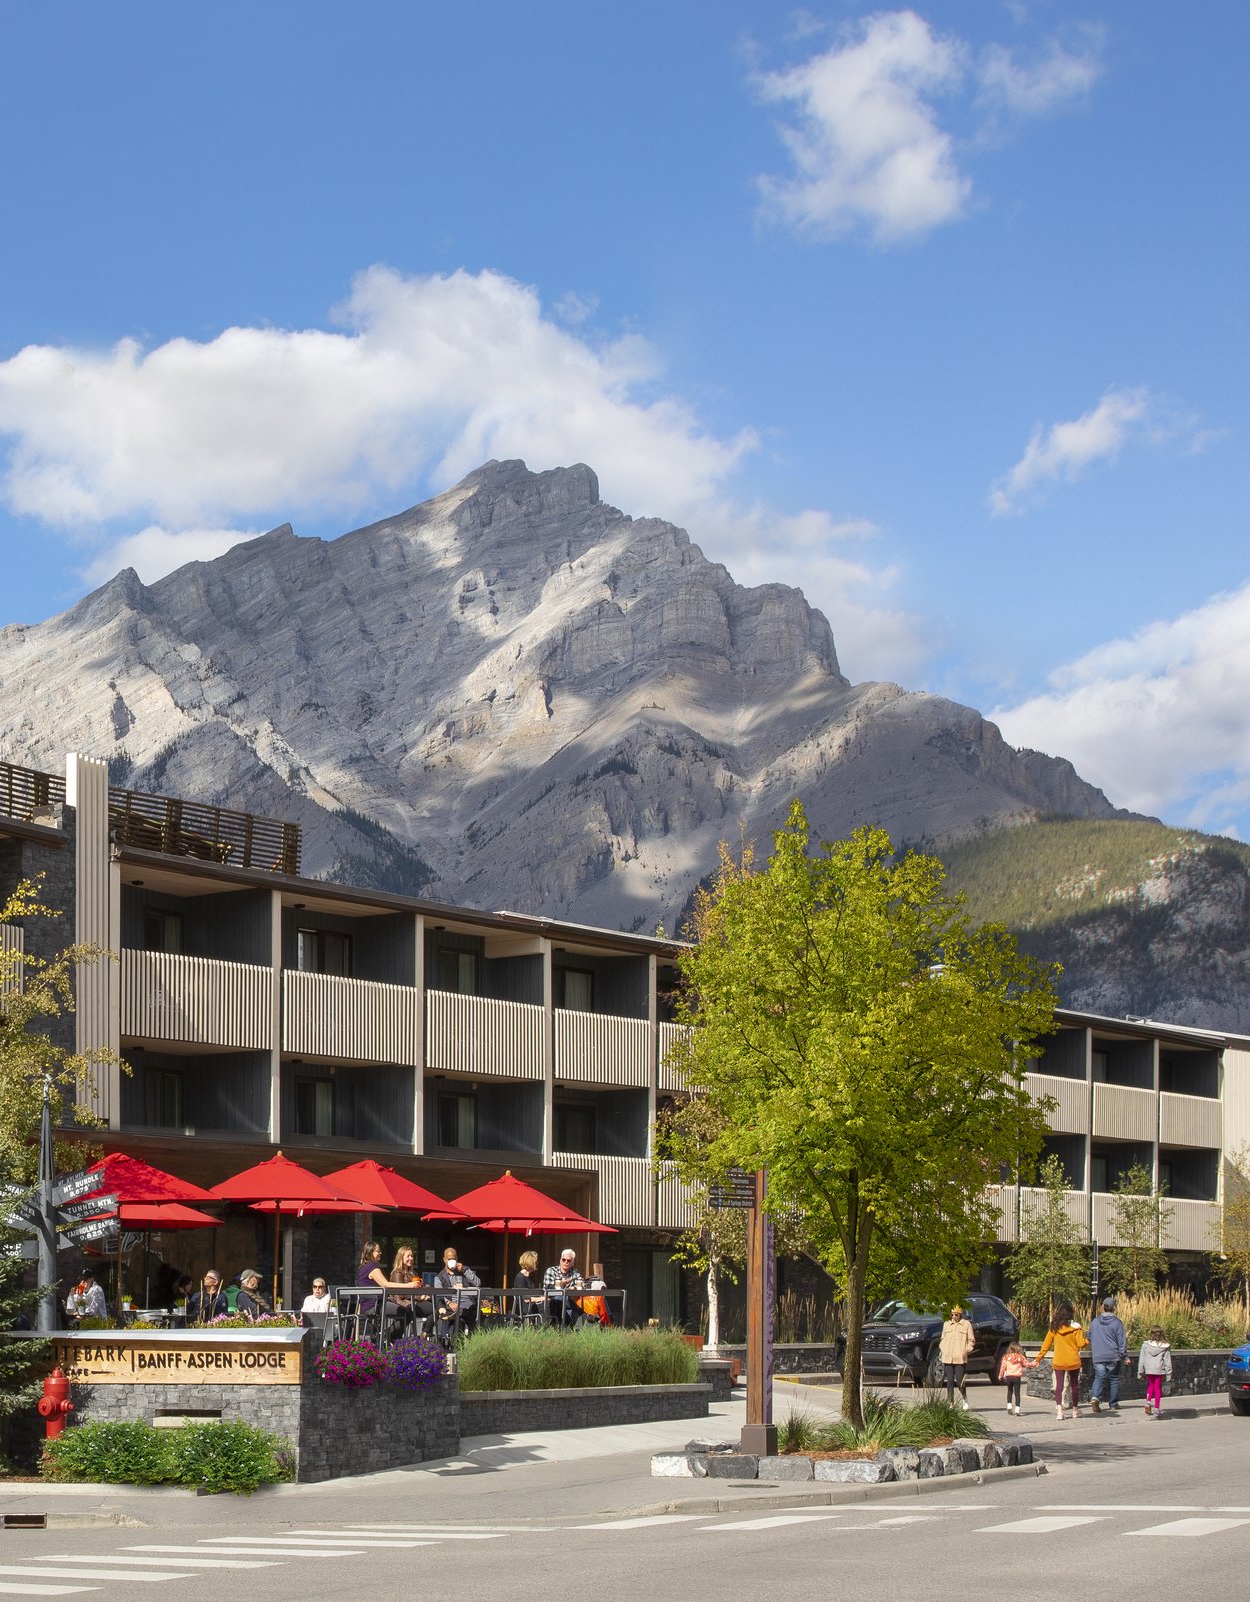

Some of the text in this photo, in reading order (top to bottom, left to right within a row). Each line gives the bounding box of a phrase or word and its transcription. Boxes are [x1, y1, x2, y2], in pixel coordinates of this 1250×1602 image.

[63, 1174, 99, 1193] MT. RUNDLE
[67, 1198, 114, 1214] TUNNEL MTN.
[67, 1219, 115, 1238] FAIRHOLME RANGE
[44, 1344, 128, 1362] ITEBARK
[138, 1353, 286, 1369] BANFF ASPEN LODGE
[65, 1368, 90, 1377] CAFE
